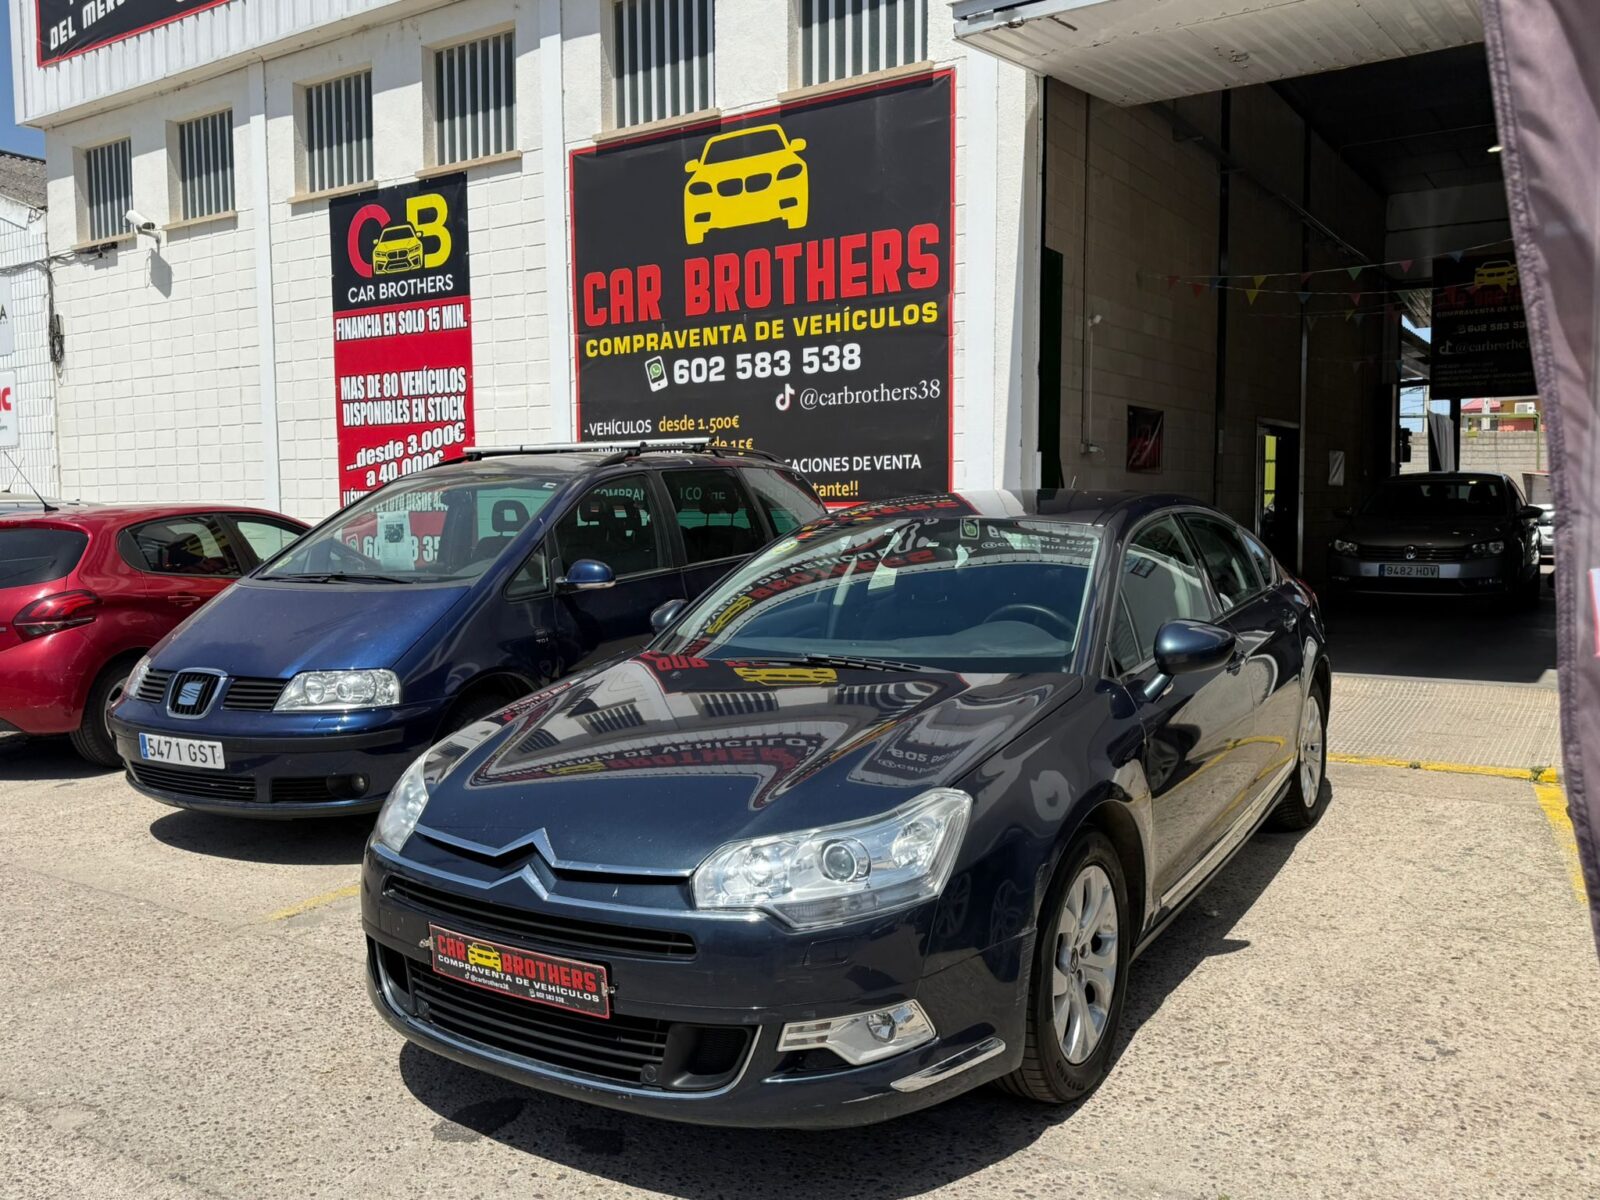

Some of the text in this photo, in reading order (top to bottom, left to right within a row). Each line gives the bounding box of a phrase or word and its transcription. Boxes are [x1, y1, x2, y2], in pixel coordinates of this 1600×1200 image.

[50, 16, 77, 50] DEL
[348, 274, 454, 303] CAR BROTHERS
[583, 222, 940, 327] CAR BROTHERS
[335, 304, 468, 341] FINANCIA EN SOLO 15 MIN.
[585, 301, 939, 358] COMPRAVENTA DE VEHÍCULOS
[673, 342, 861, 385] 602 583 538
[340, 366, 467, 400] MAS DE 80 VEHÍCULOS
[799, 379, 941, 411] @carbrothers38
[342, 395, 466, 427] DISPONIBLES EN STOCK
[658, 414, 695, 432] desde
[697, 415, 740, 434] 1.500€
[407, 422, 466, 455] 3.000€
[366, 470, 376, 487] a
[785, 453, 922, 473] ACIONES DE VENTA
[812, 480, 859, 497] tante!!
[1386, 566, 1413, 577] 9482
[147, 738, 216, 765] 5471 GST
[437, 934, 597, 993] CAR BROTHERS
[437, 954, 600, 1003] COMPRAVENTA DE VEHÍCULOS
